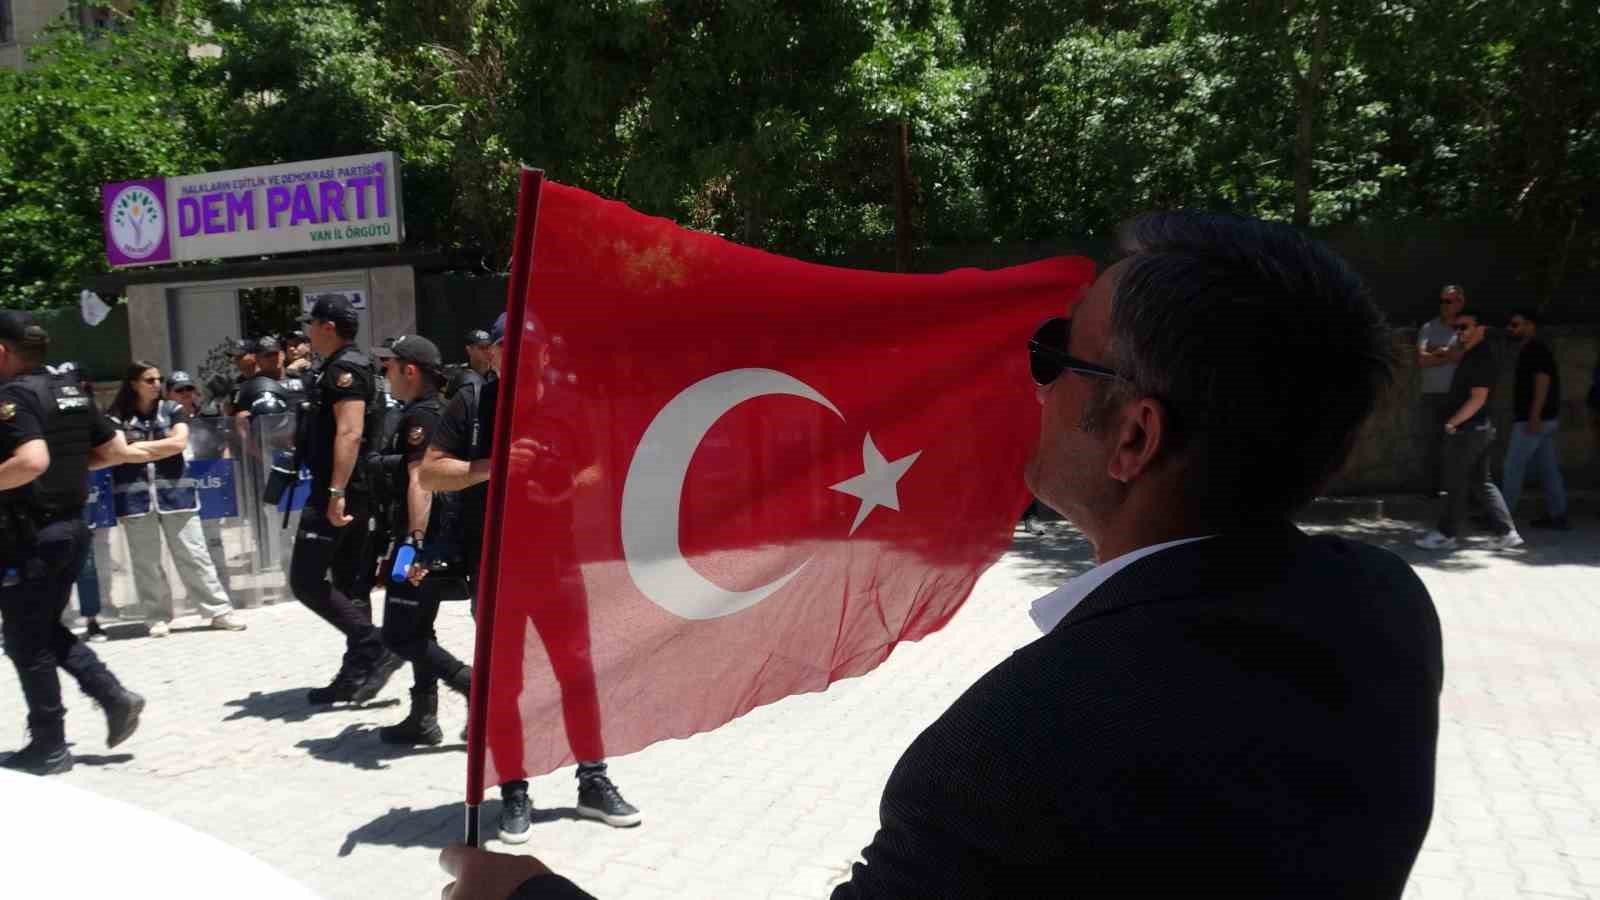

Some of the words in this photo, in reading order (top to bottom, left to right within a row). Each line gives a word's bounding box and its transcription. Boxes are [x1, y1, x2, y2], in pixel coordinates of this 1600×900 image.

[268, 175, 281, 185] VE
[281, 167, 336, 184] DEMOKRASİ
[177, 190, 256, 237] DEM
[266, 160, 386, 229] PARTİ
[310, 229, 332, 241] VAN
[334, 227, 343, 240] İL
[345, 222, 391, 240] ÖRGÜTÜ
